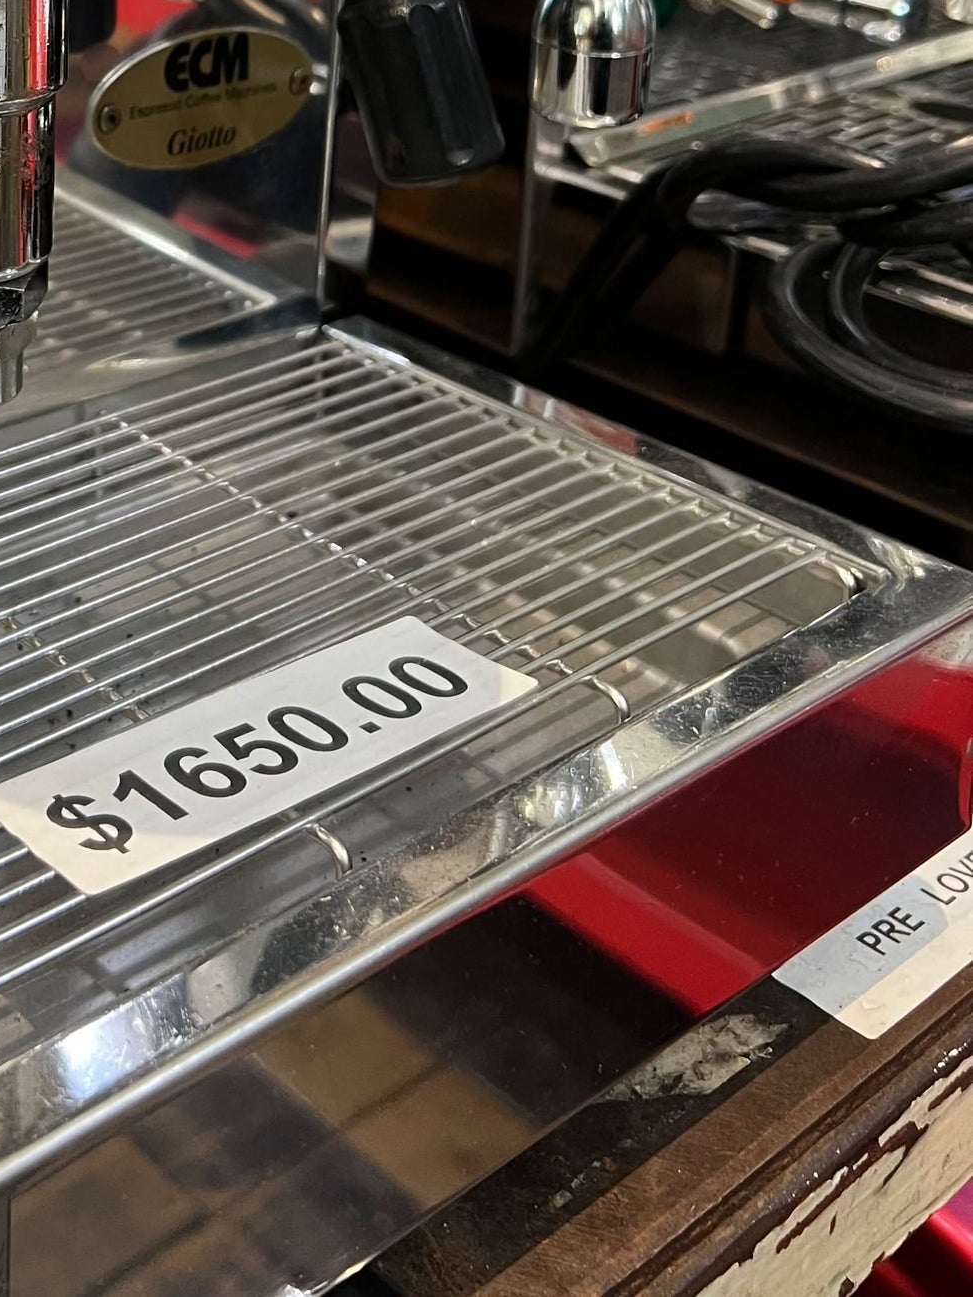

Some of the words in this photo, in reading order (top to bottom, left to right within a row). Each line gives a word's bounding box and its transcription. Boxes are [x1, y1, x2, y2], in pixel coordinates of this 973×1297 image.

[163, 31, 249, 93] ECM
[167, 125, 236, 156] Giotto
[45, 655, 469, 855] $1650.00
[855, 906, 926, 956] PRE
